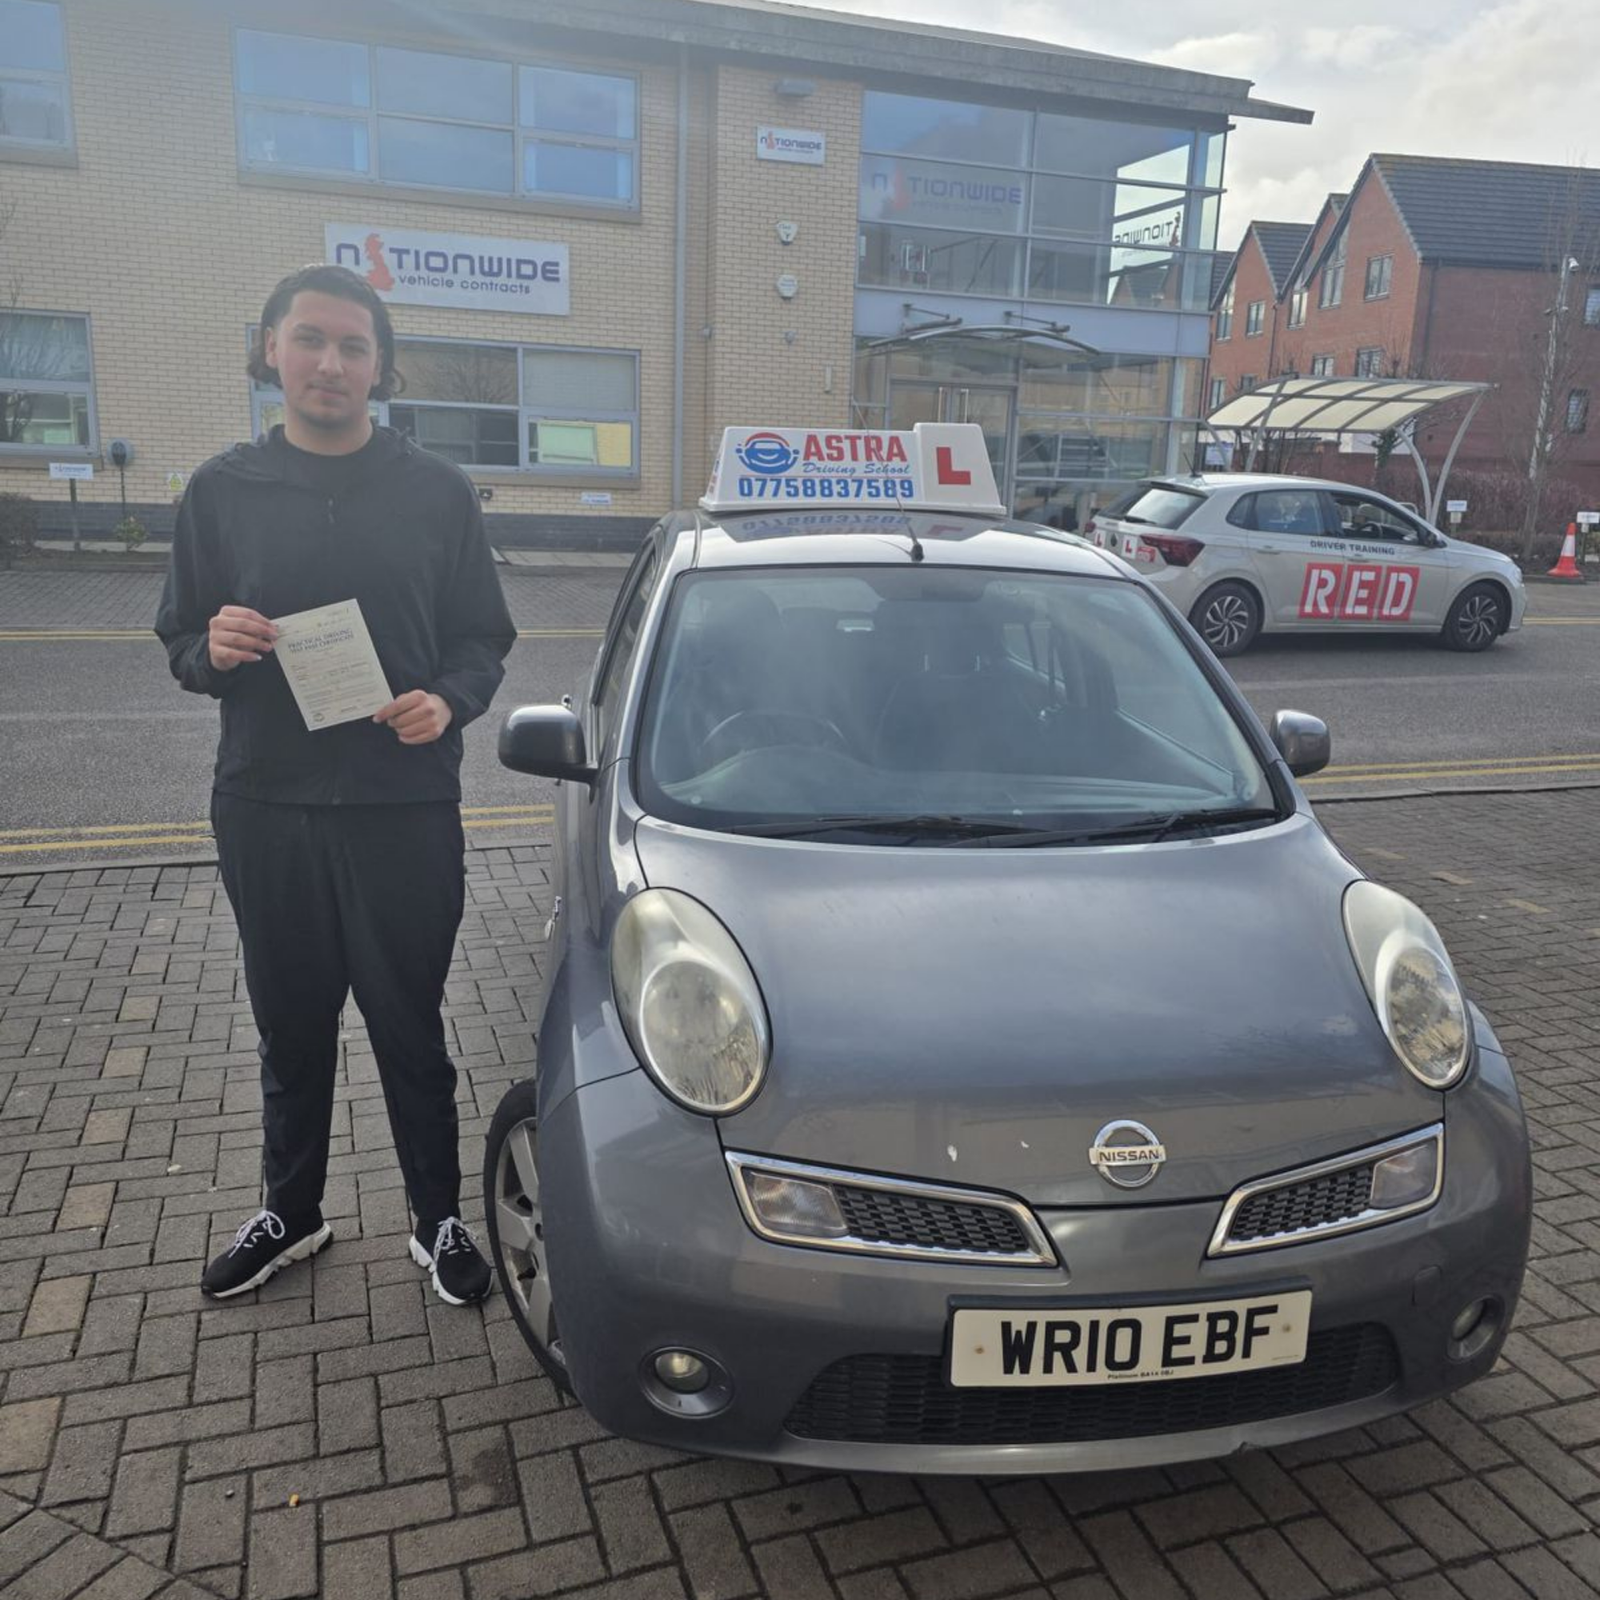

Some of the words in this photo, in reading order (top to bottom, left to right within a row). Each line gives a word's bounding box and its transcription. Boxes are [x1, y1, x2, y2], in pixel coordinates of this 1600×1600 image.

[399, 274, 454, 289] vehicle
[460, 279, 531, 295] contracts
[802, 434, 908, 462] ASTRA
[802, 462, 857, 475] Driving
[863, 463, 911, 475] School
[936, 446, 972, 486] L
[738, 477, 914, 499] 07758837589
[1309, 540, 1346, 551] DRIVER
[1348, 543, 1396, 556] TRAINING
[1303, 568, 1415, 617] RED
[1099, 1149, 1160, 1162] NISSAN
[1001, 1318, 1142, 1375] WR10
[1161, 1304, 1279, 1368] EBF
